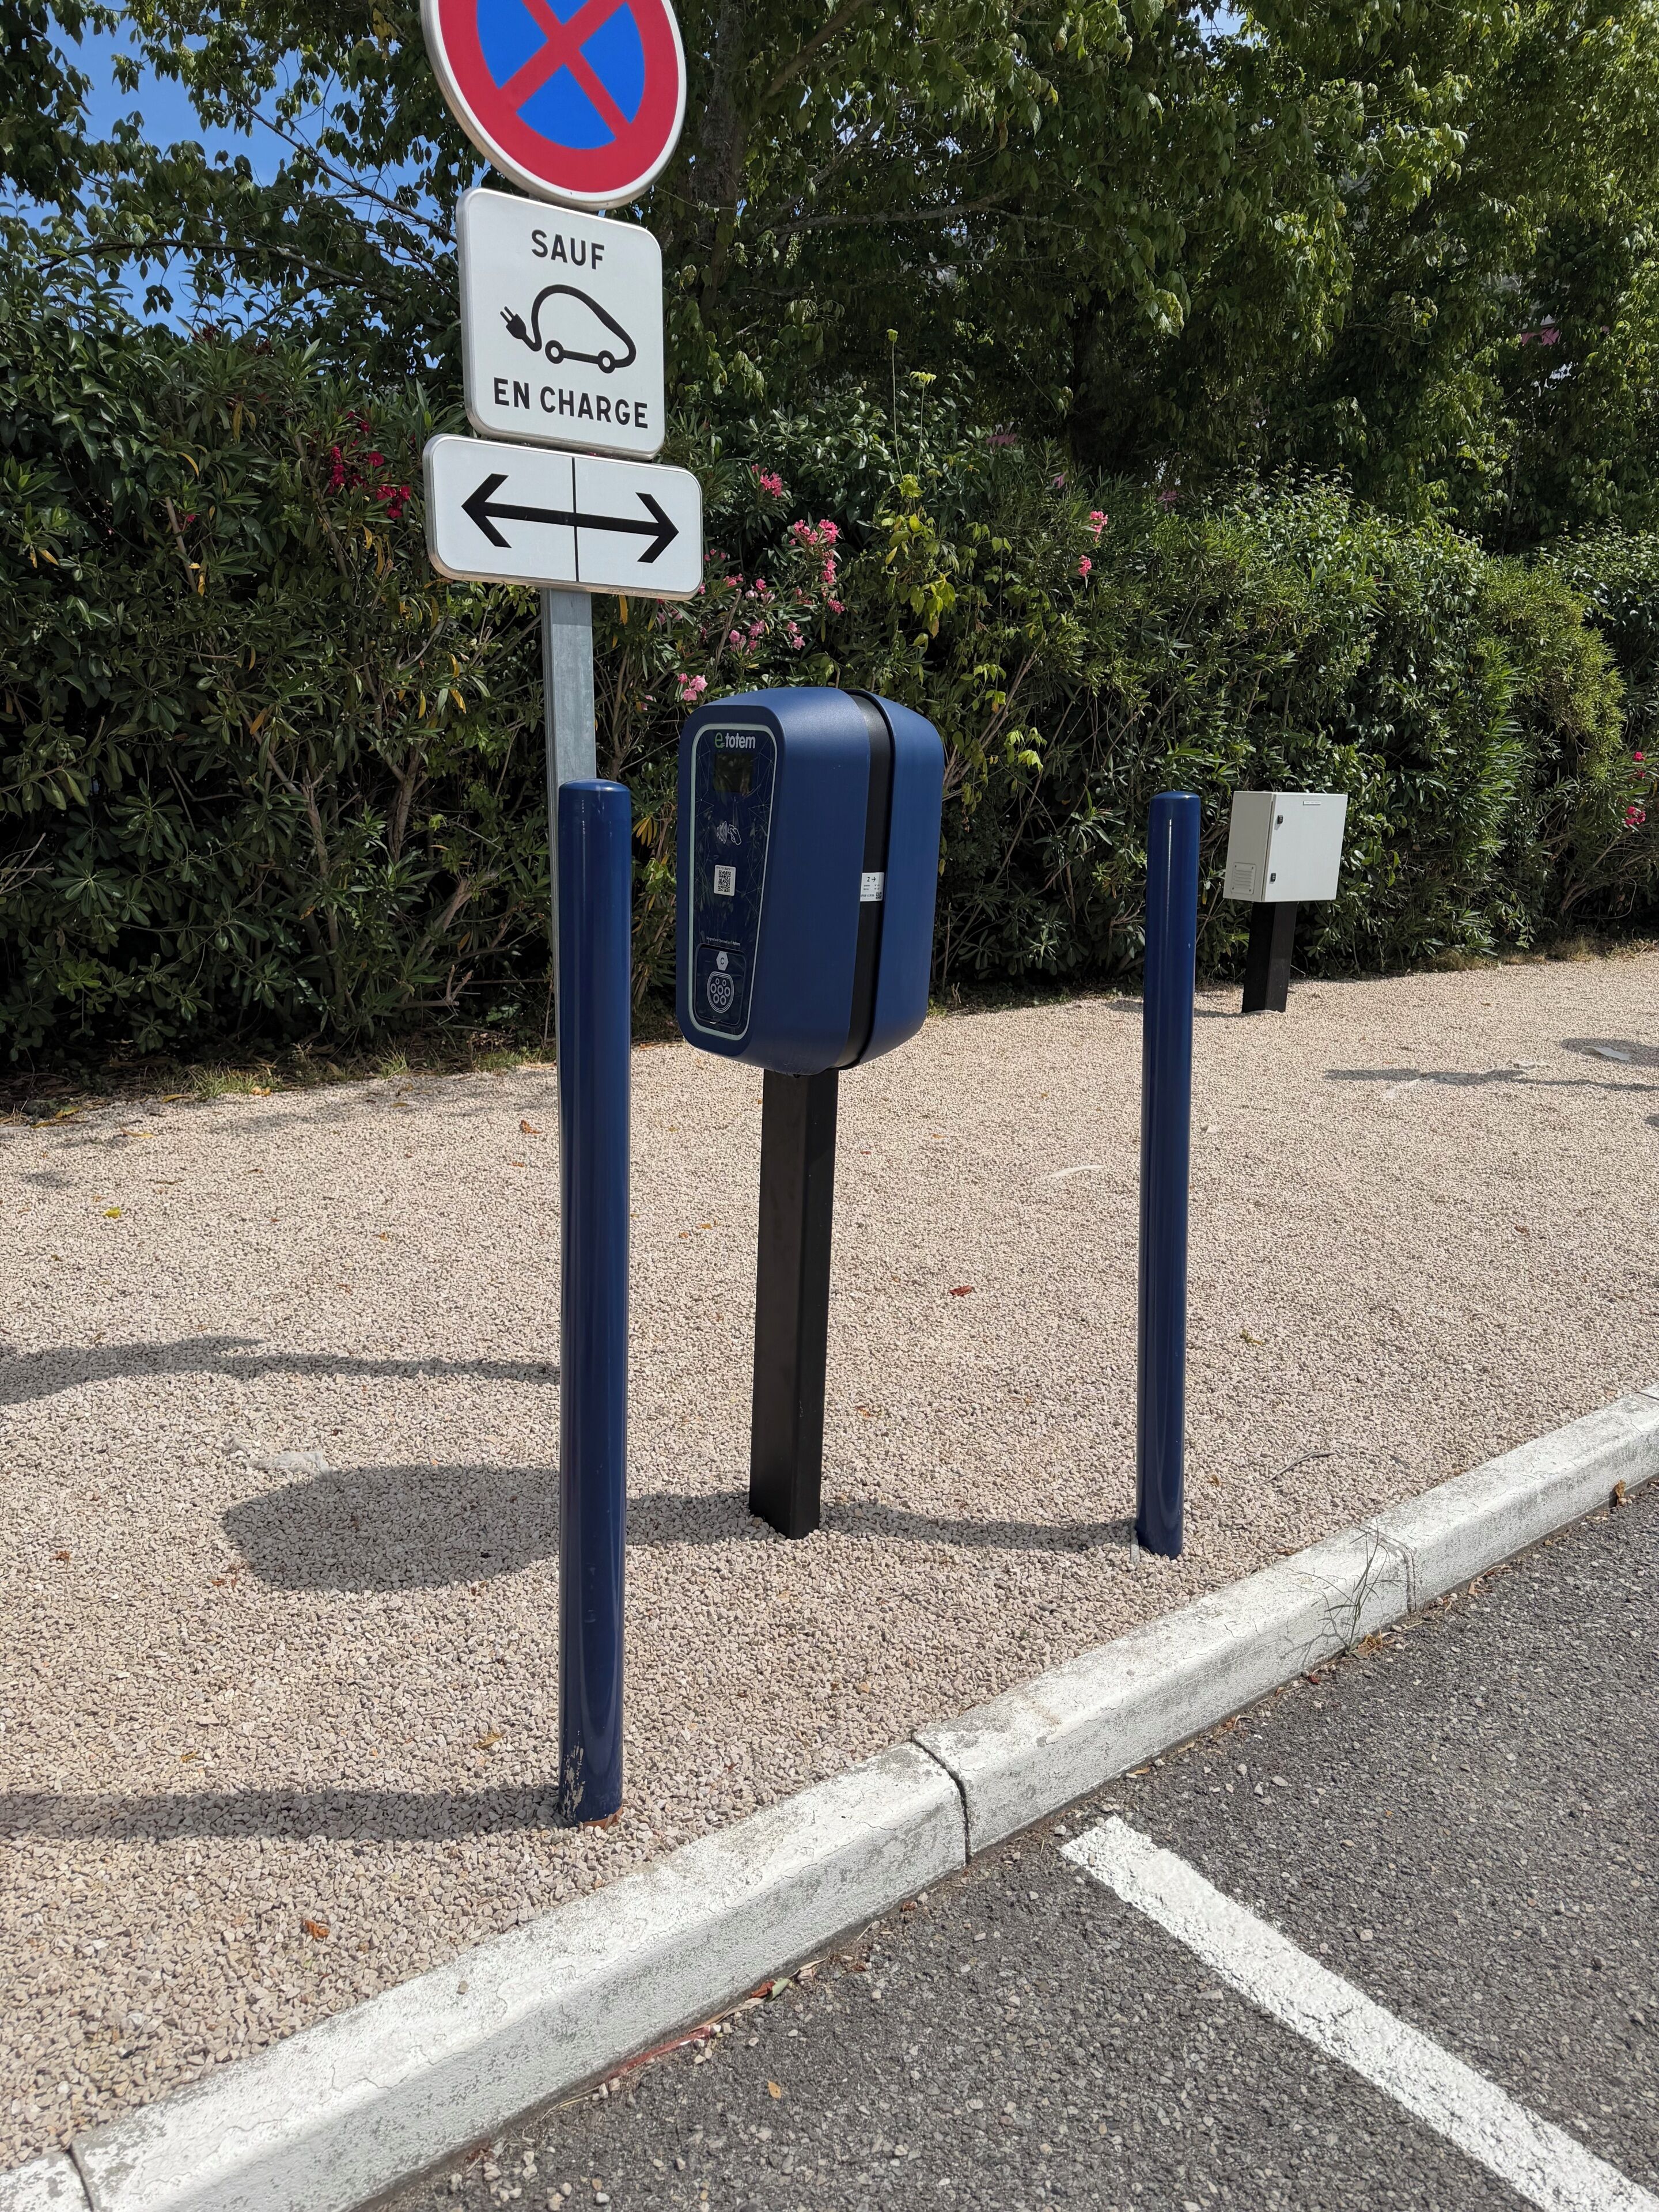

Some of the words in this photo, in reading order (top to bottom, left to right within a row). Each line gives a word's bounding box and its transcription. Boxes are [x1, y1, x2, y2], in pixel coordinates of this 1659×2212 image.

[531, 229, 605, 270] SAUF
[494, 377, 530, 410] EN
[540, 386, 648, 429] CHARGE
